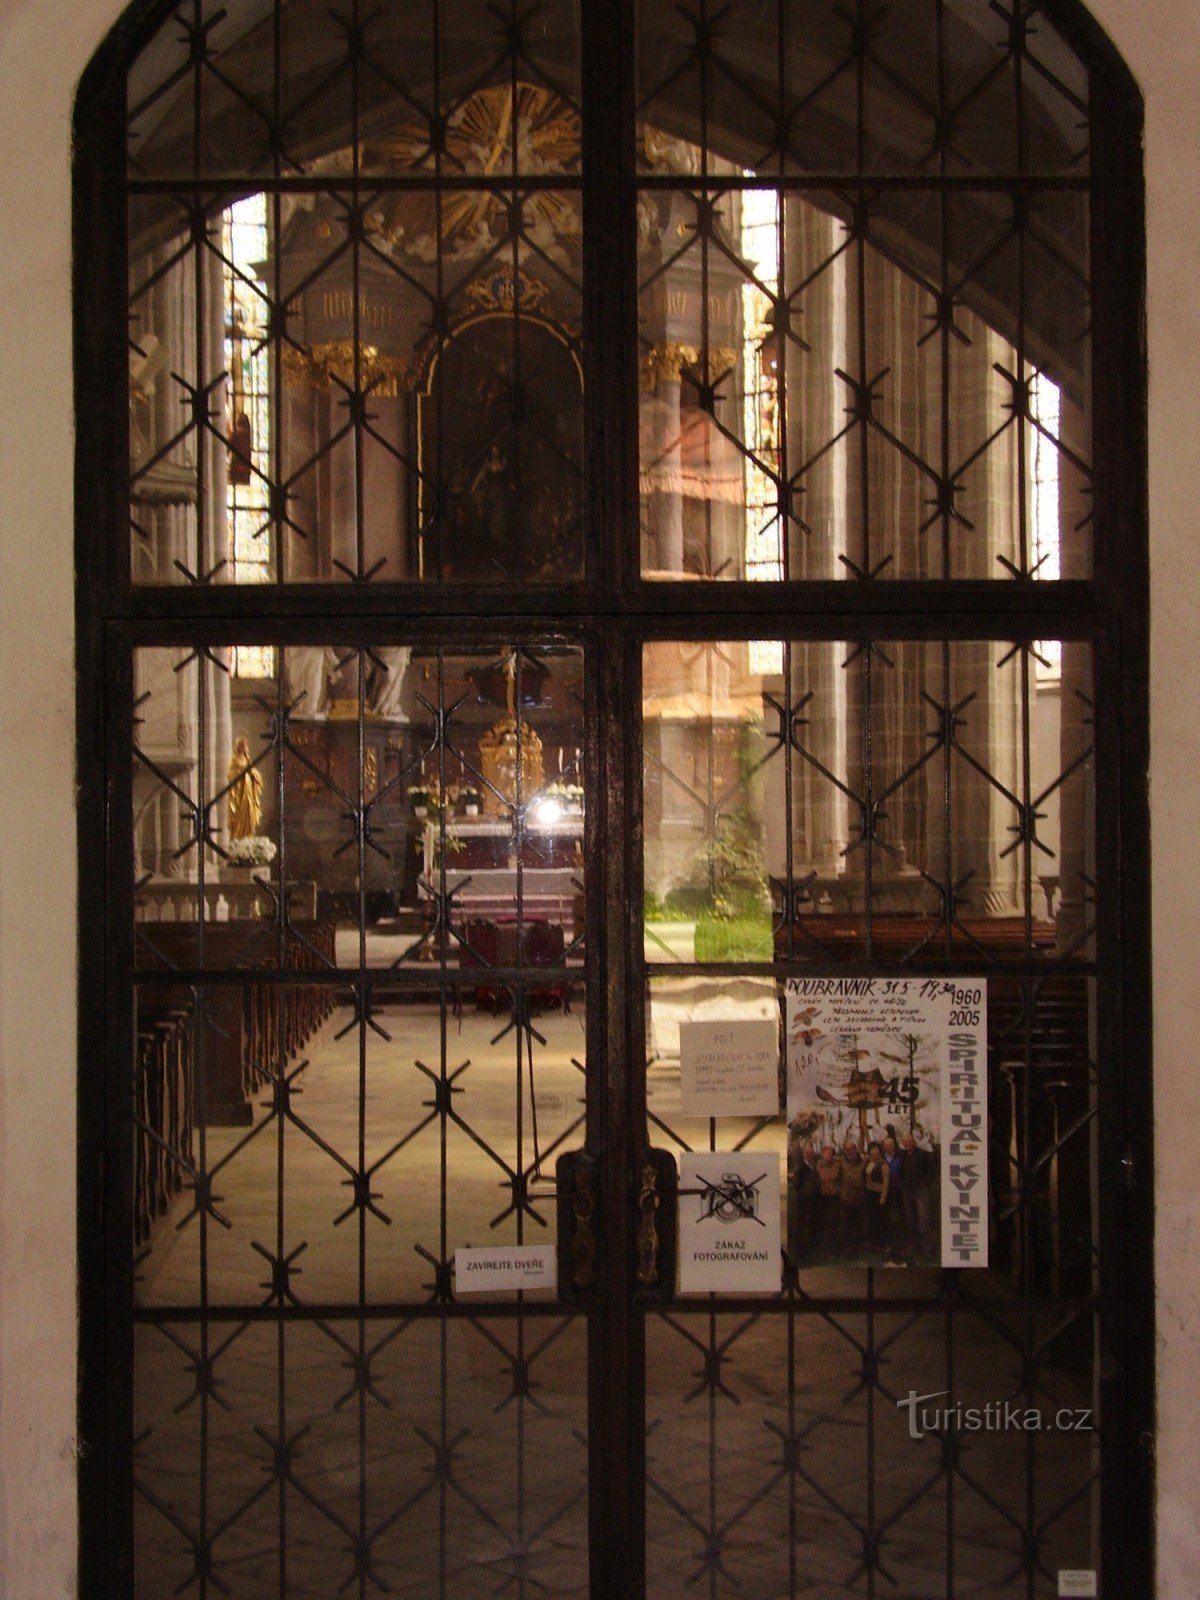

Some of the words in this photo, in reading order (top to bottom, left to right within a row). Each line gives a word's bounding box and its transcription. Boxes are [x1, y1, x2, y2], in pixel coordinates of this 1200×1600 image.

[950, 989, 981, 1006] 1960
[948, 1010, 980, 1027] 2005
[878, 1076, 920, 1104] 45
[887, 1104, 909, 1115] LET
[950, 1163, 981, 1261] KVINTET
[715, 1240, 746, 1250] ZÁKAZ
[693, 1251, 768, 1261] FOTOGRAFOVÁNÍ
